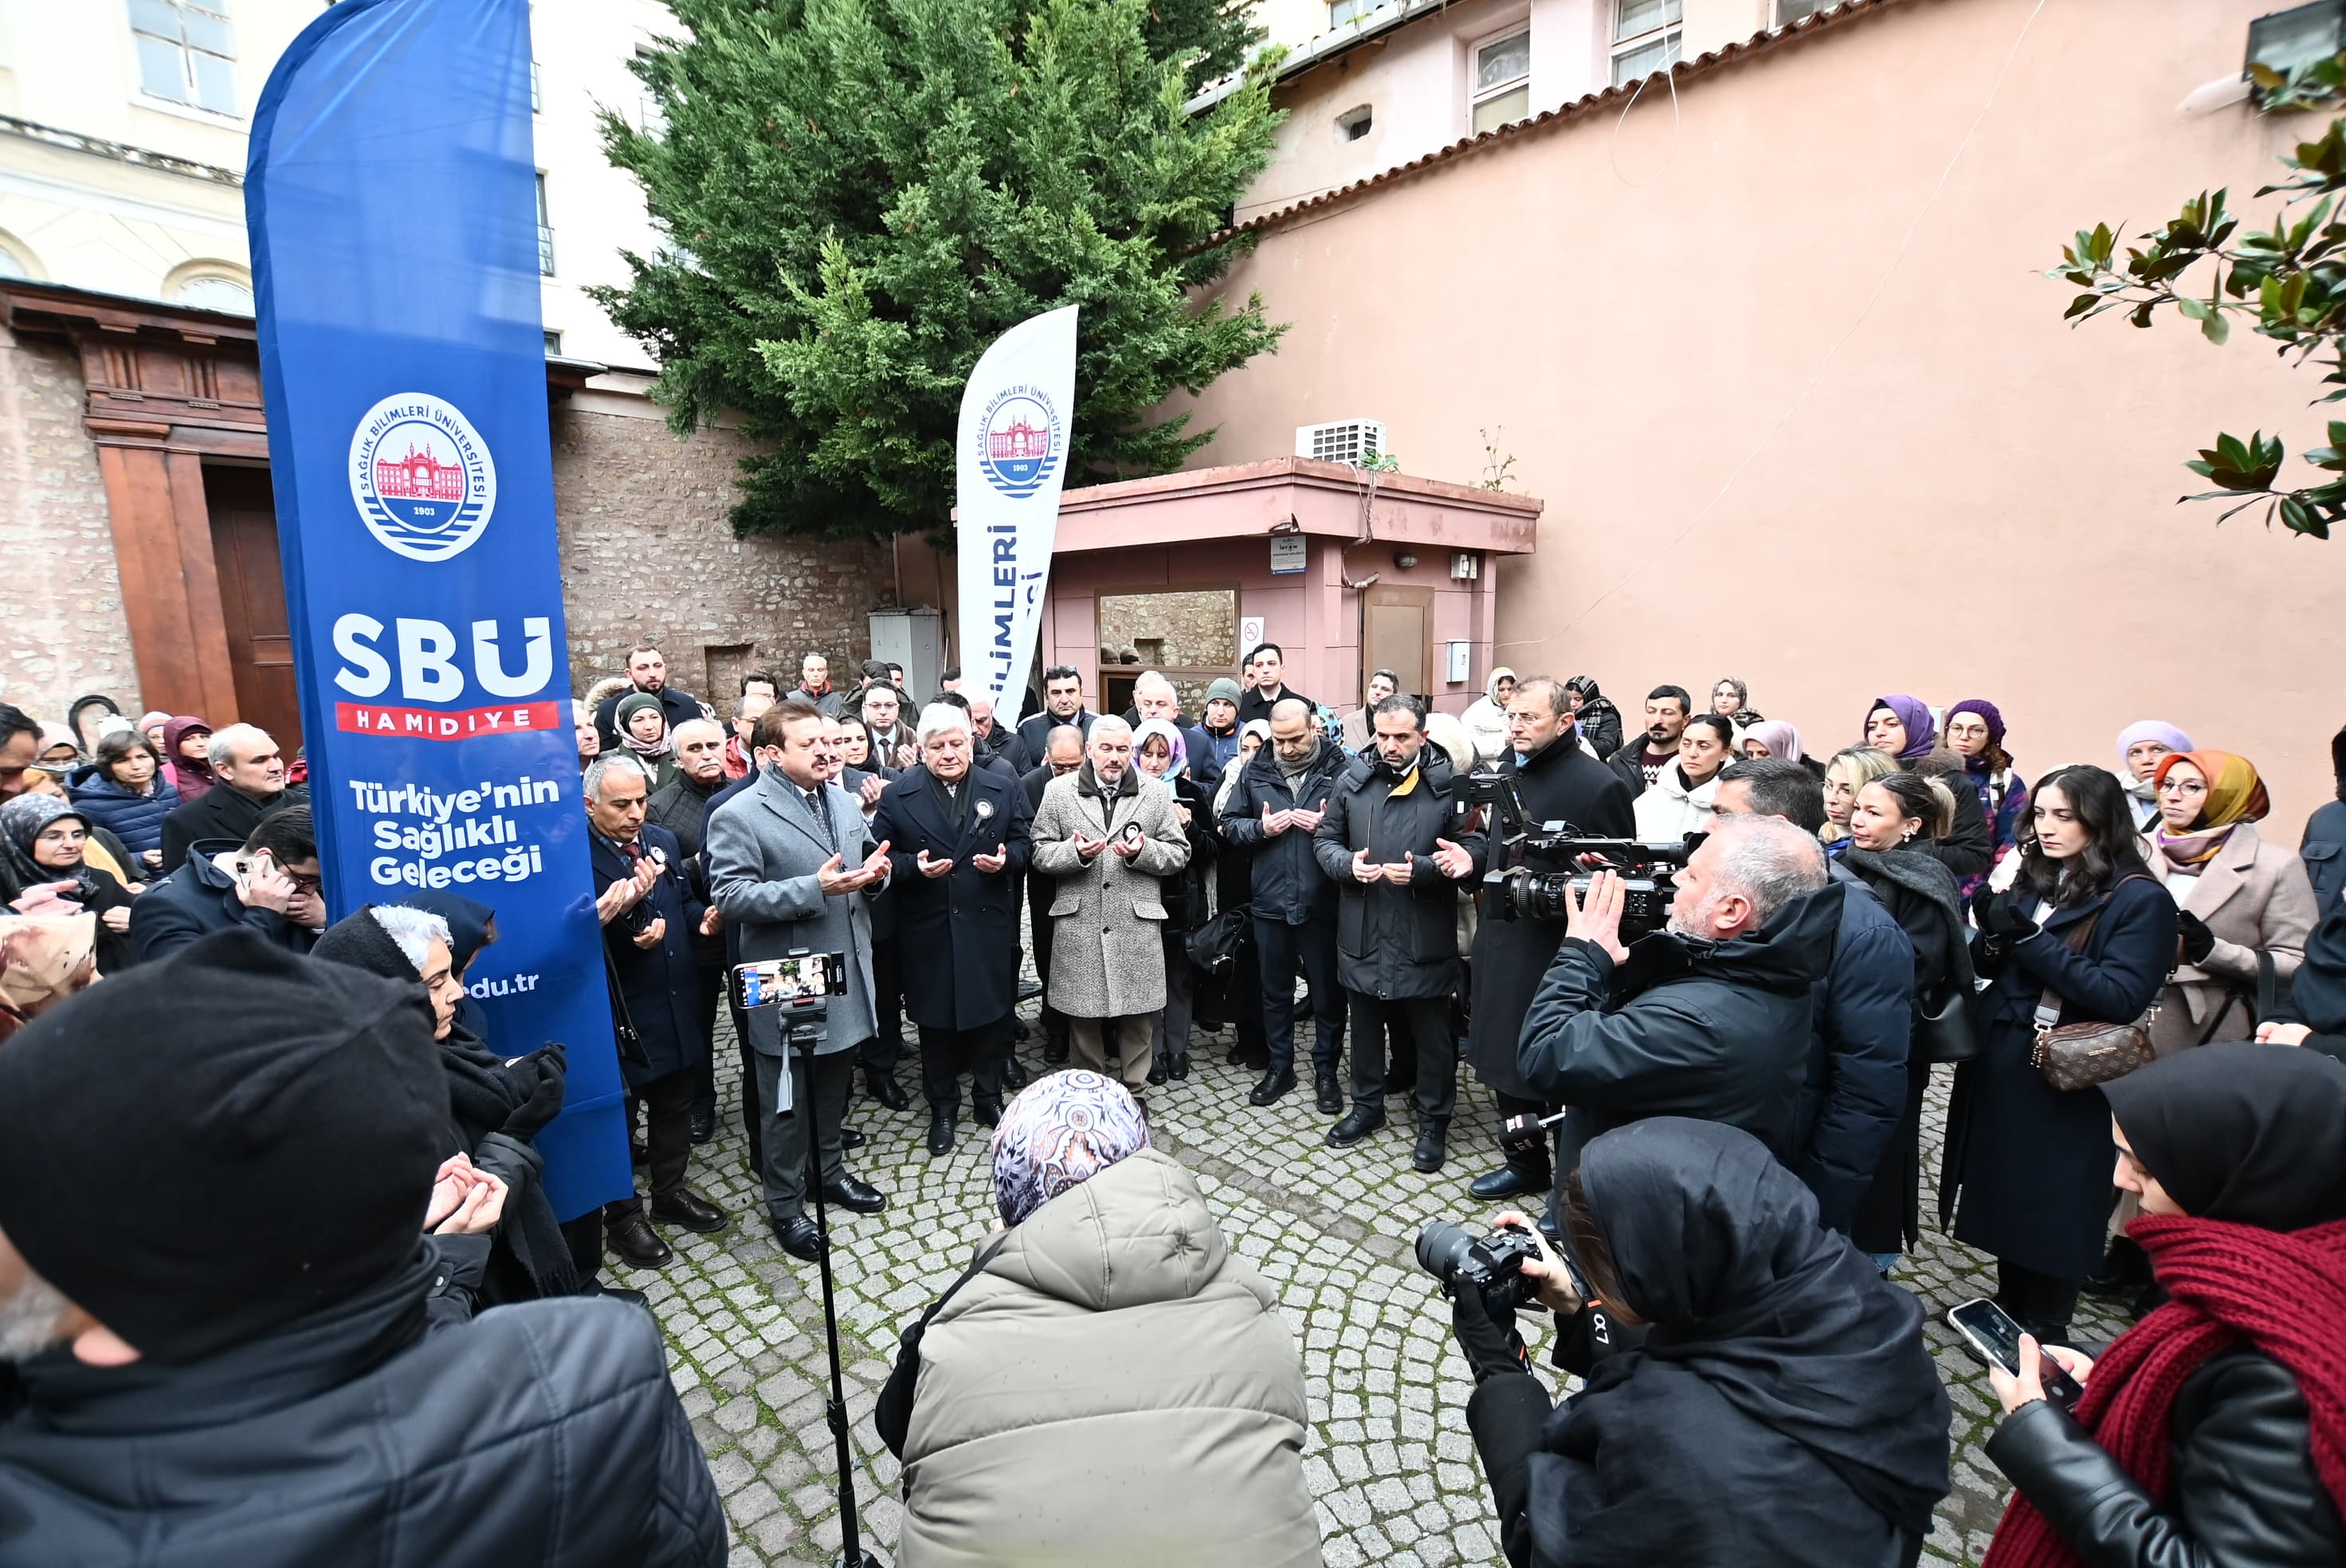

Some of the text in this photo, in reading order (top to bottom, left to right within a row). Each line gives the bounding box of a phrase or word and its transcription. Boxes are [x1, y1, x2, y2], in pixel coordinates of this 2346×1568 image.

[359, 405, 487, 498] SAĞLIK BİLİMLERİ ÜNİVERSİTESİ
[414, 507, 435, 516] 1903
[987, 525, 1017, 708] İLİMLERİ
[349, 776, 559, 824] Türkiye’nin
[374, 815, 517, 860] Sağlıklı
[370, 845, 543, 888] Geleceği
